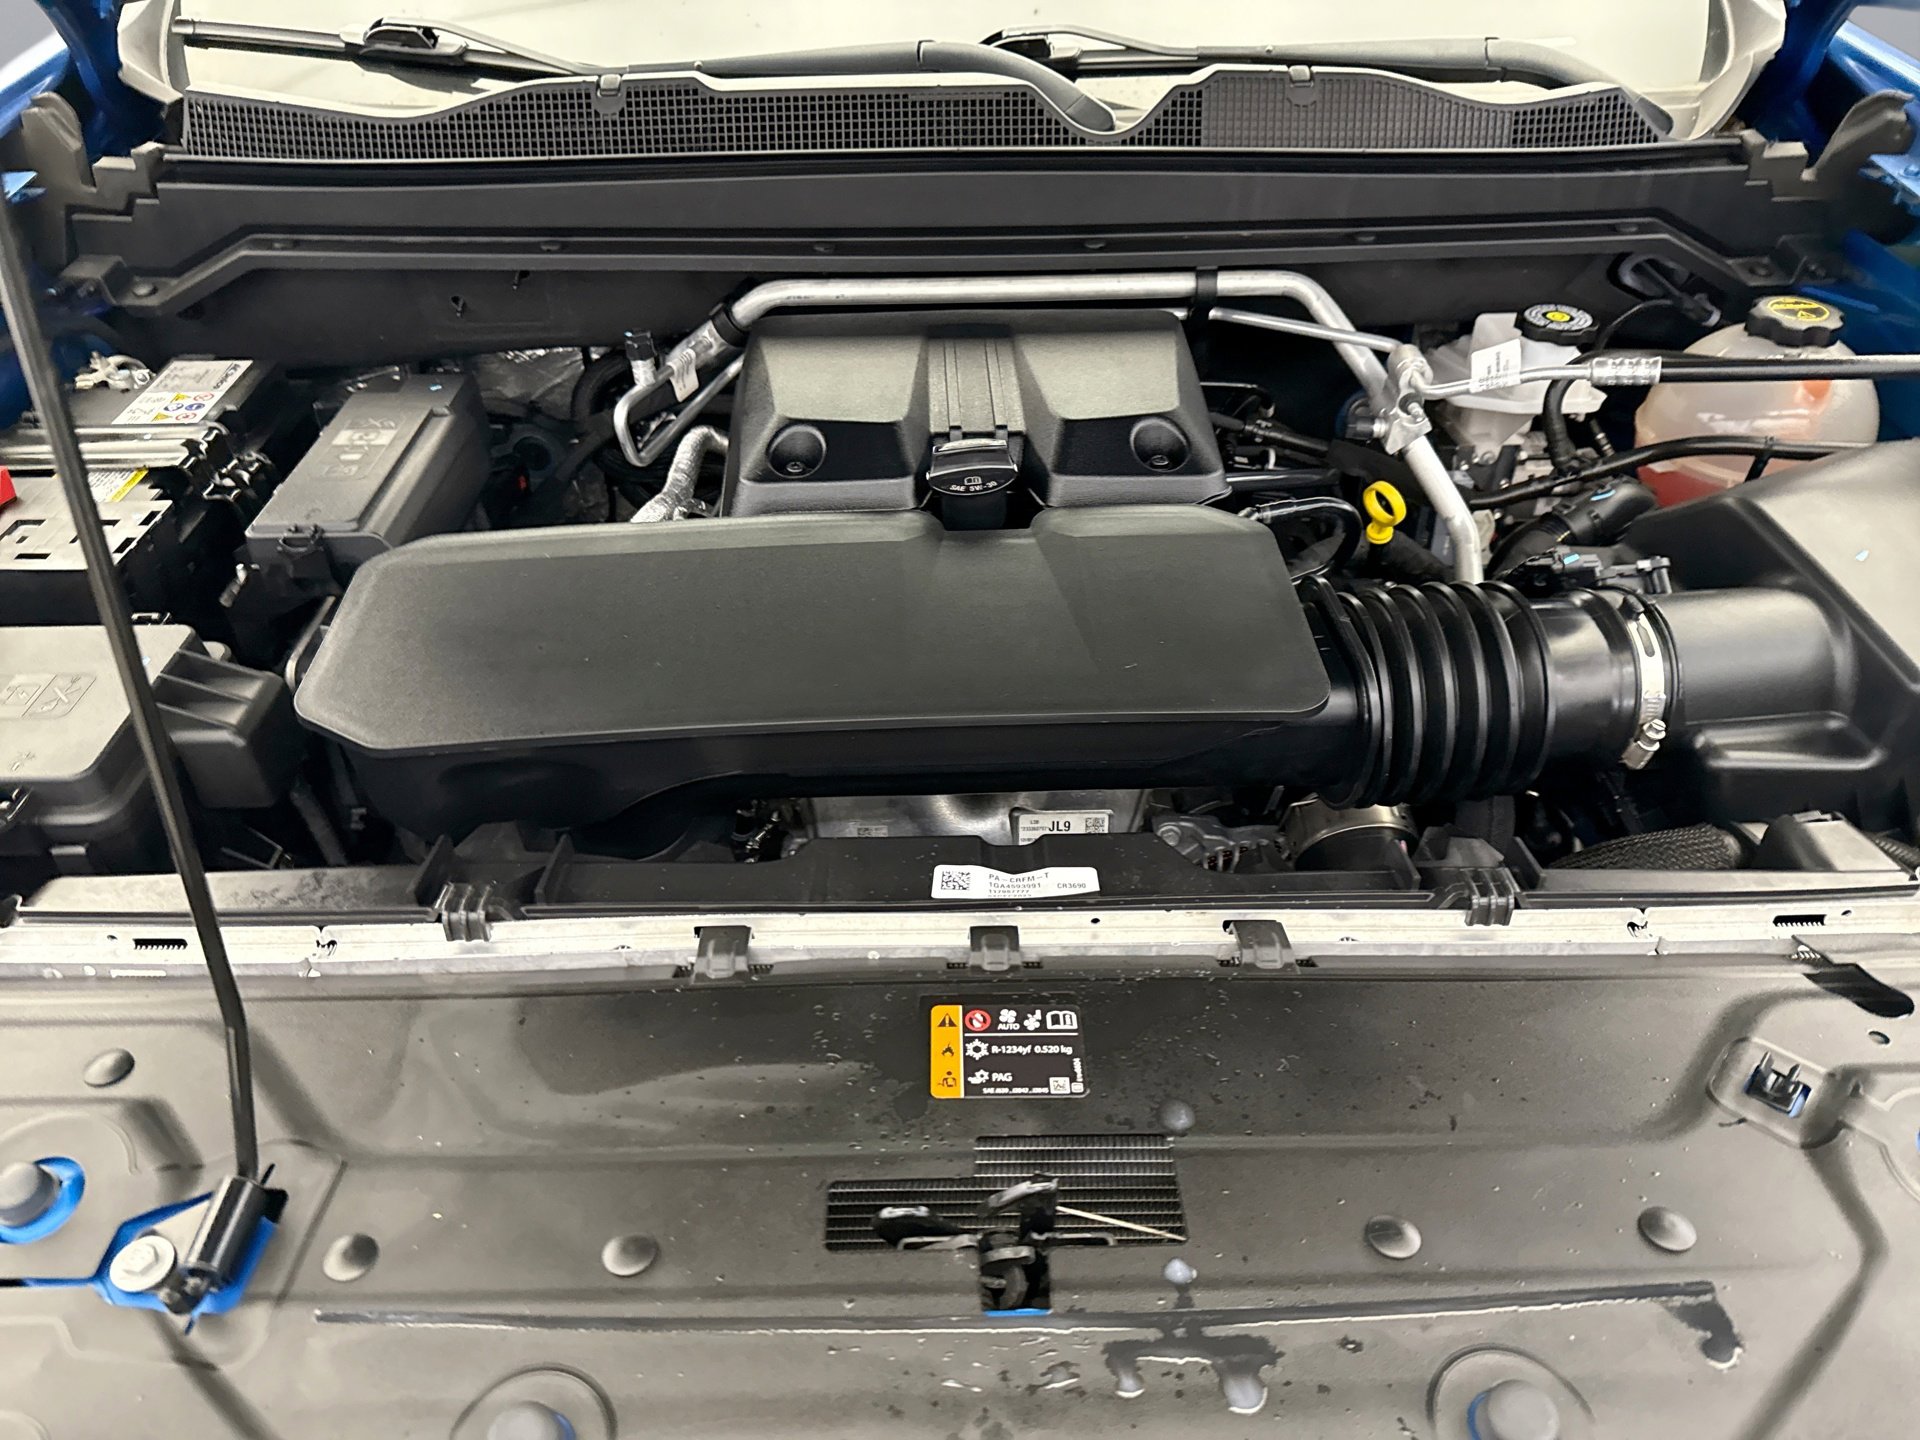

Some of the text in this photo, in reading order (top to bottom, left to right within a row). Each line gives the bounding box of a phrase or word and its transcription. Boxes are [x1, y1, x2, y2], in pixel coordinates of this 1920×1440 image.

[949, 480, 998, 492] SAE 5W-30
[1048, 820, 1071, 832] JL9
[997, 1023, 1021, 1031] AUTO
[991, 1044, 1073, 1056] R-1234yf 0.520 kg
[991, 1072, 1013, 1082] PAG
